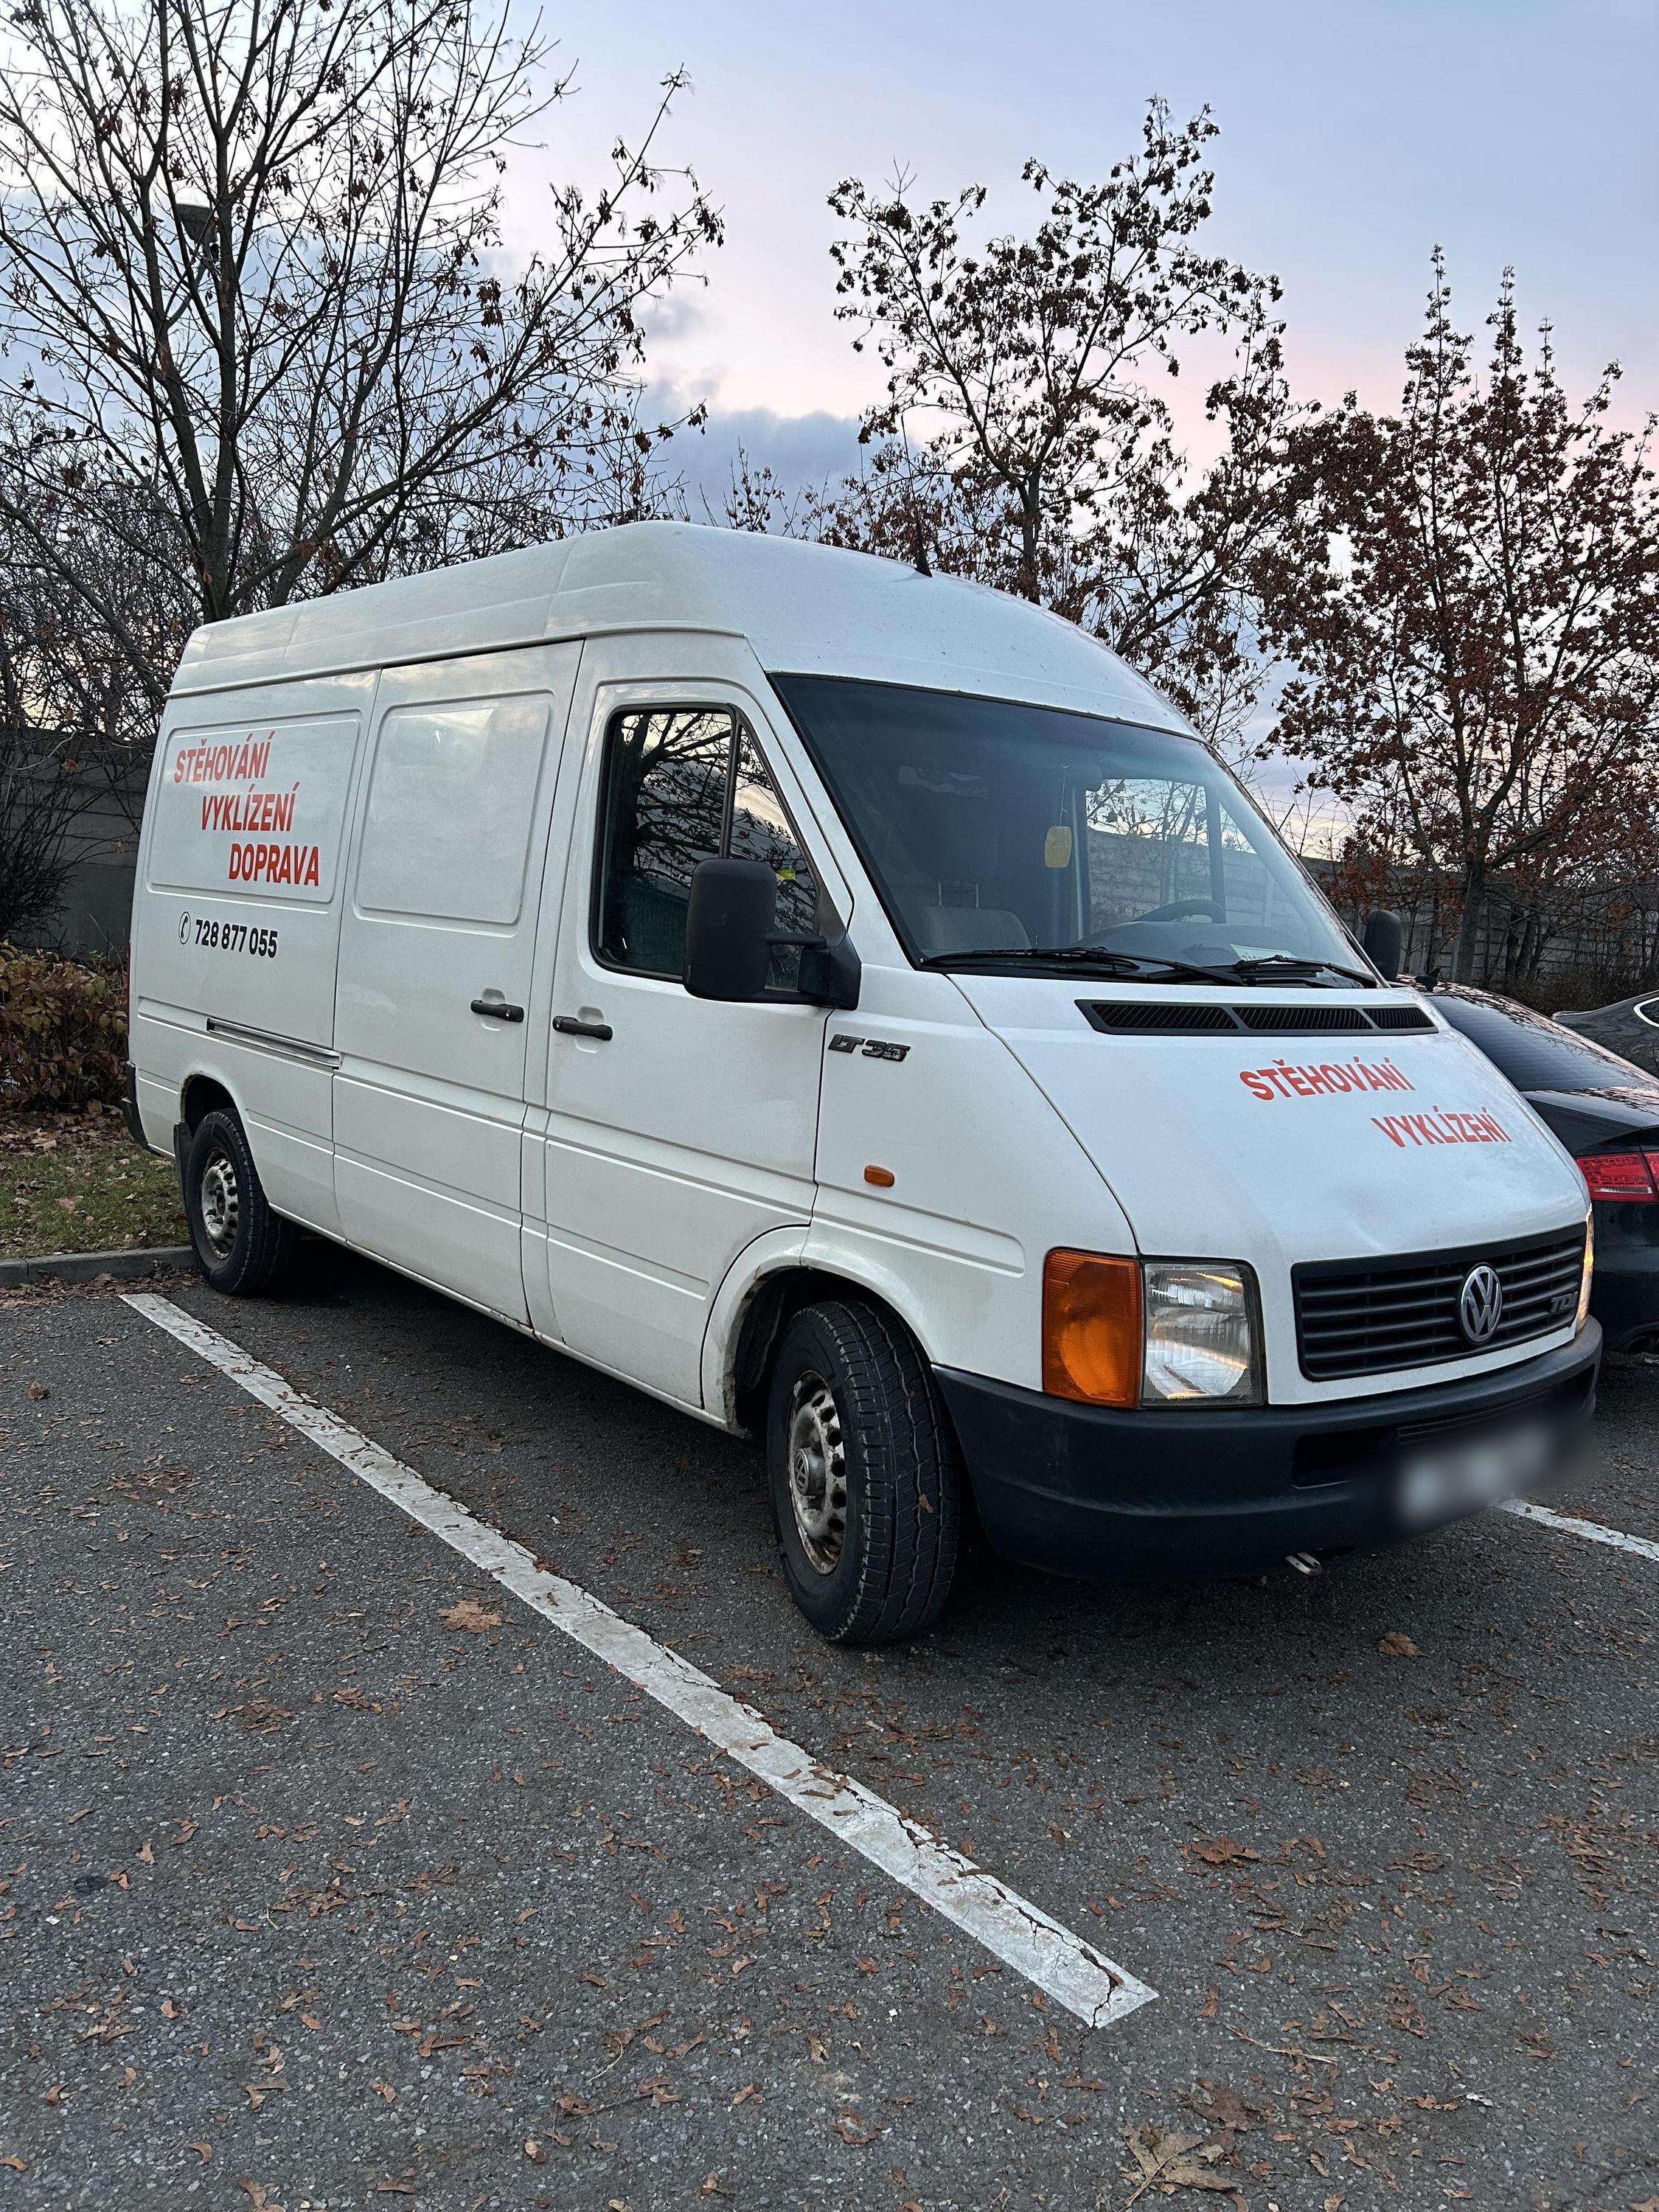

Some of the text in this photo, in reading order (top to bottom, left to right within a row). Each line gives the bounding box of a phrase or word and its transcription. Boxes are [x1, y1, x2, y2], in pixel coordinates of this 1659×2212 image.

[174, 731, 276, 783] STĚHOVÁNÍ
[202, 782, 300, 832] VYKLÍZENÍ
[229, 843, 319, 886] DOPRAVA
[195, 919, 278, 959] 728 877 055
[828, 1034, 911, 1062] LT 35
[1239, 1056, 1416, 1101] STĚHOVÁNÍ
[1370, 1105, 1513, 1148] VYKLÍZENÍ
